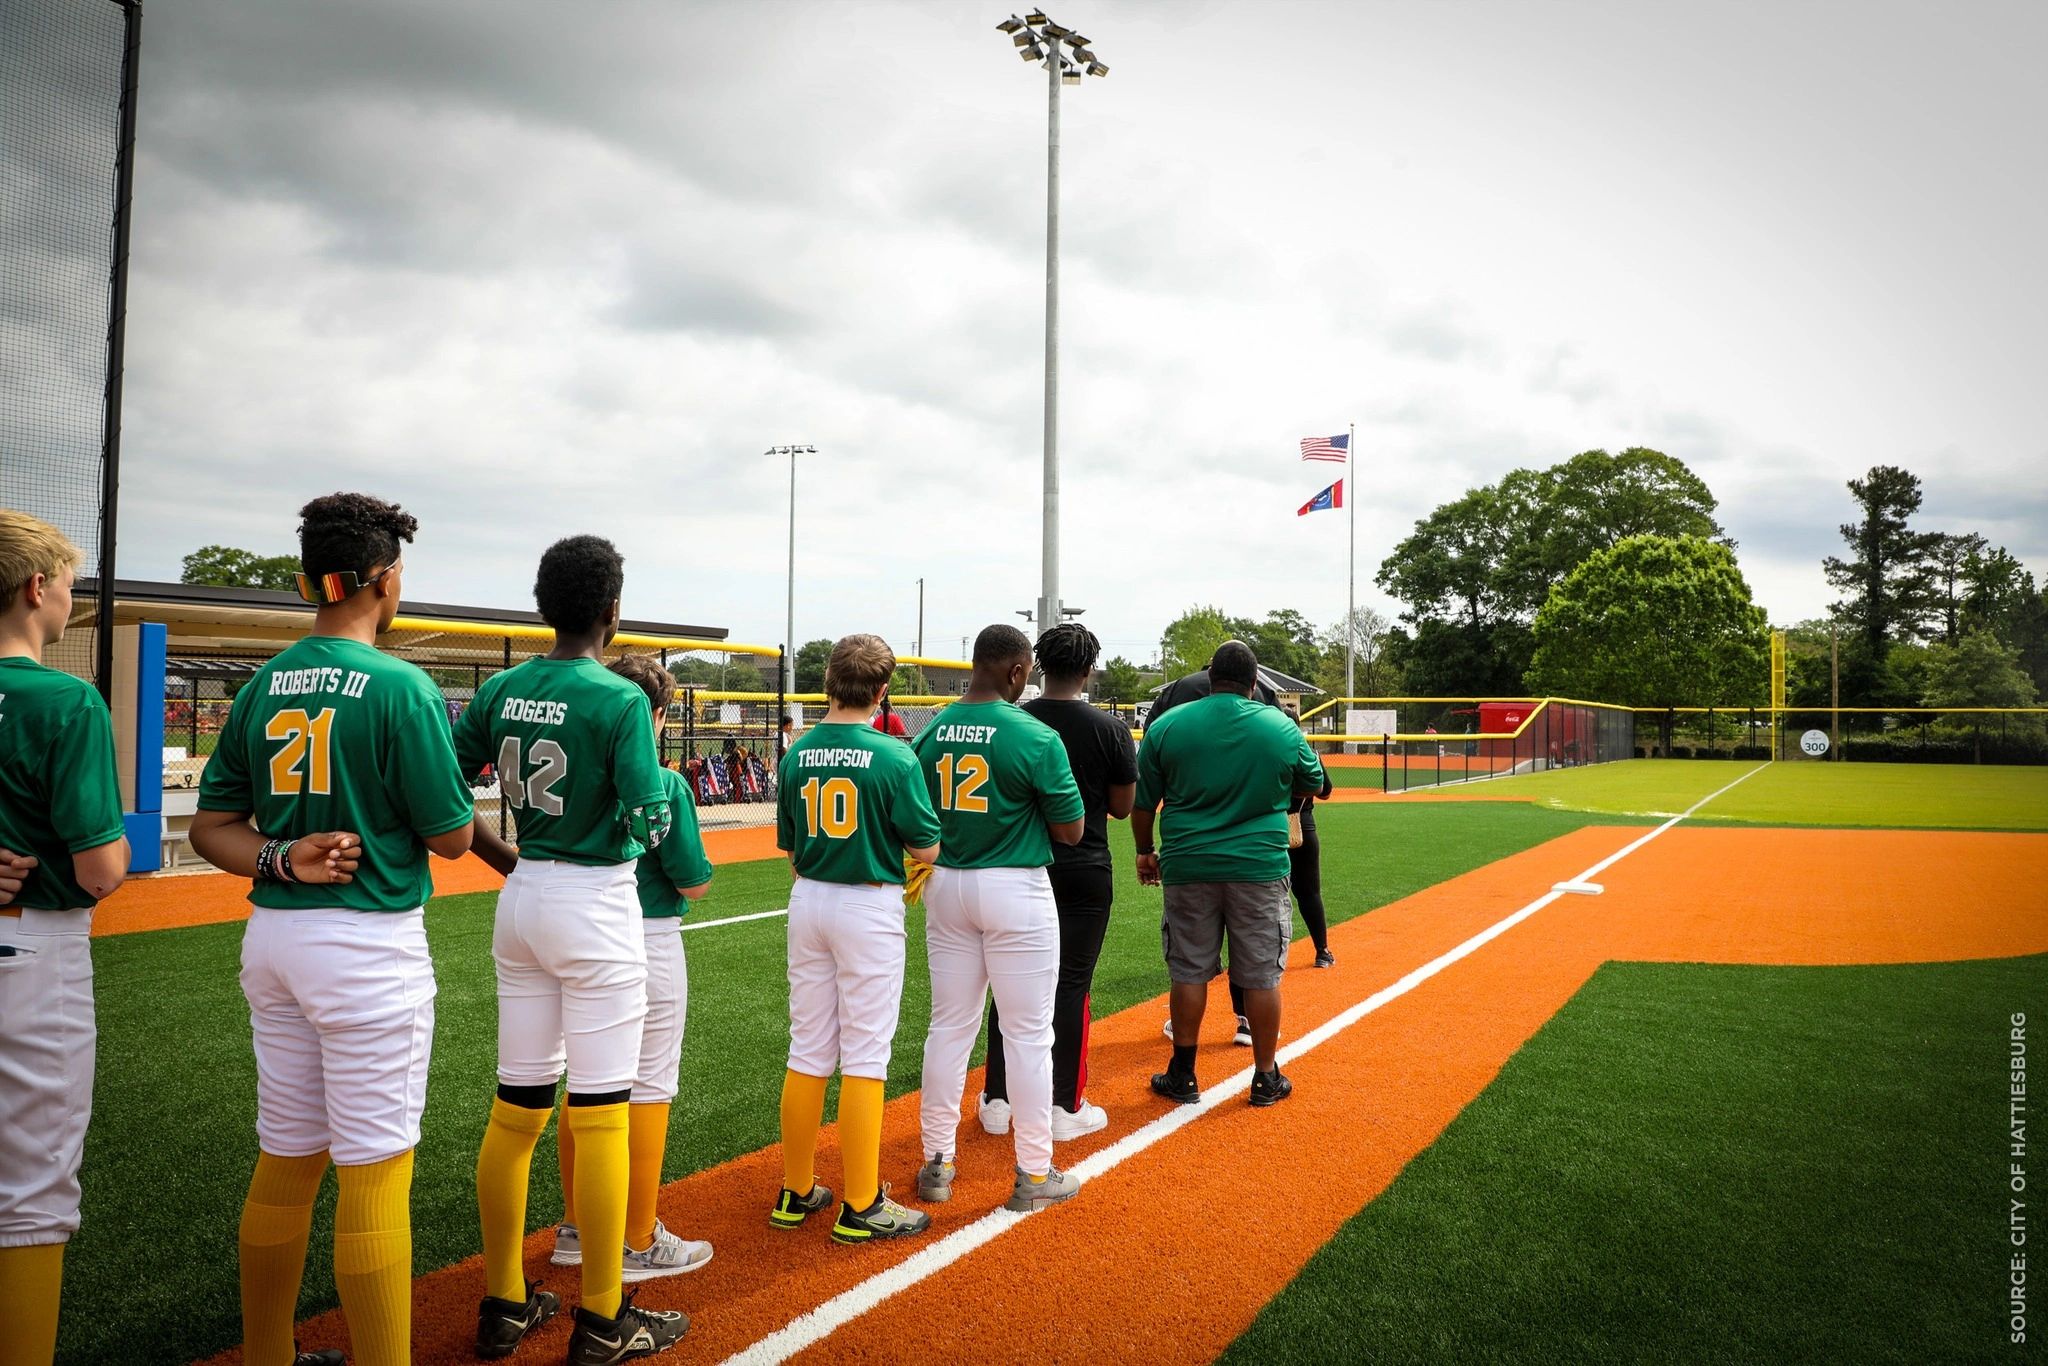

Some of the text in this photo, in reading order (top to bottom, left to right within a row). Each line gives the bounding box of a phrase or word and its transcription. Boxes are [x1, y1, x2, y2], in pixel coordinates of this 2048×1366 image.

[268, 667, 371, 699] ROBERTS III
[501, 697, 568, 726] ROGERS
[936, 724, 997, 744] CAUSEY
[1805, 742, 1826, 752] 300
[265, 707, 336, 796] 21
[798, 748, 873, 769] THOMPSON
[497, 735, 568, 816] 42
[936, 752, 990, 813] 12
[800, 776, 858, 839] 10
